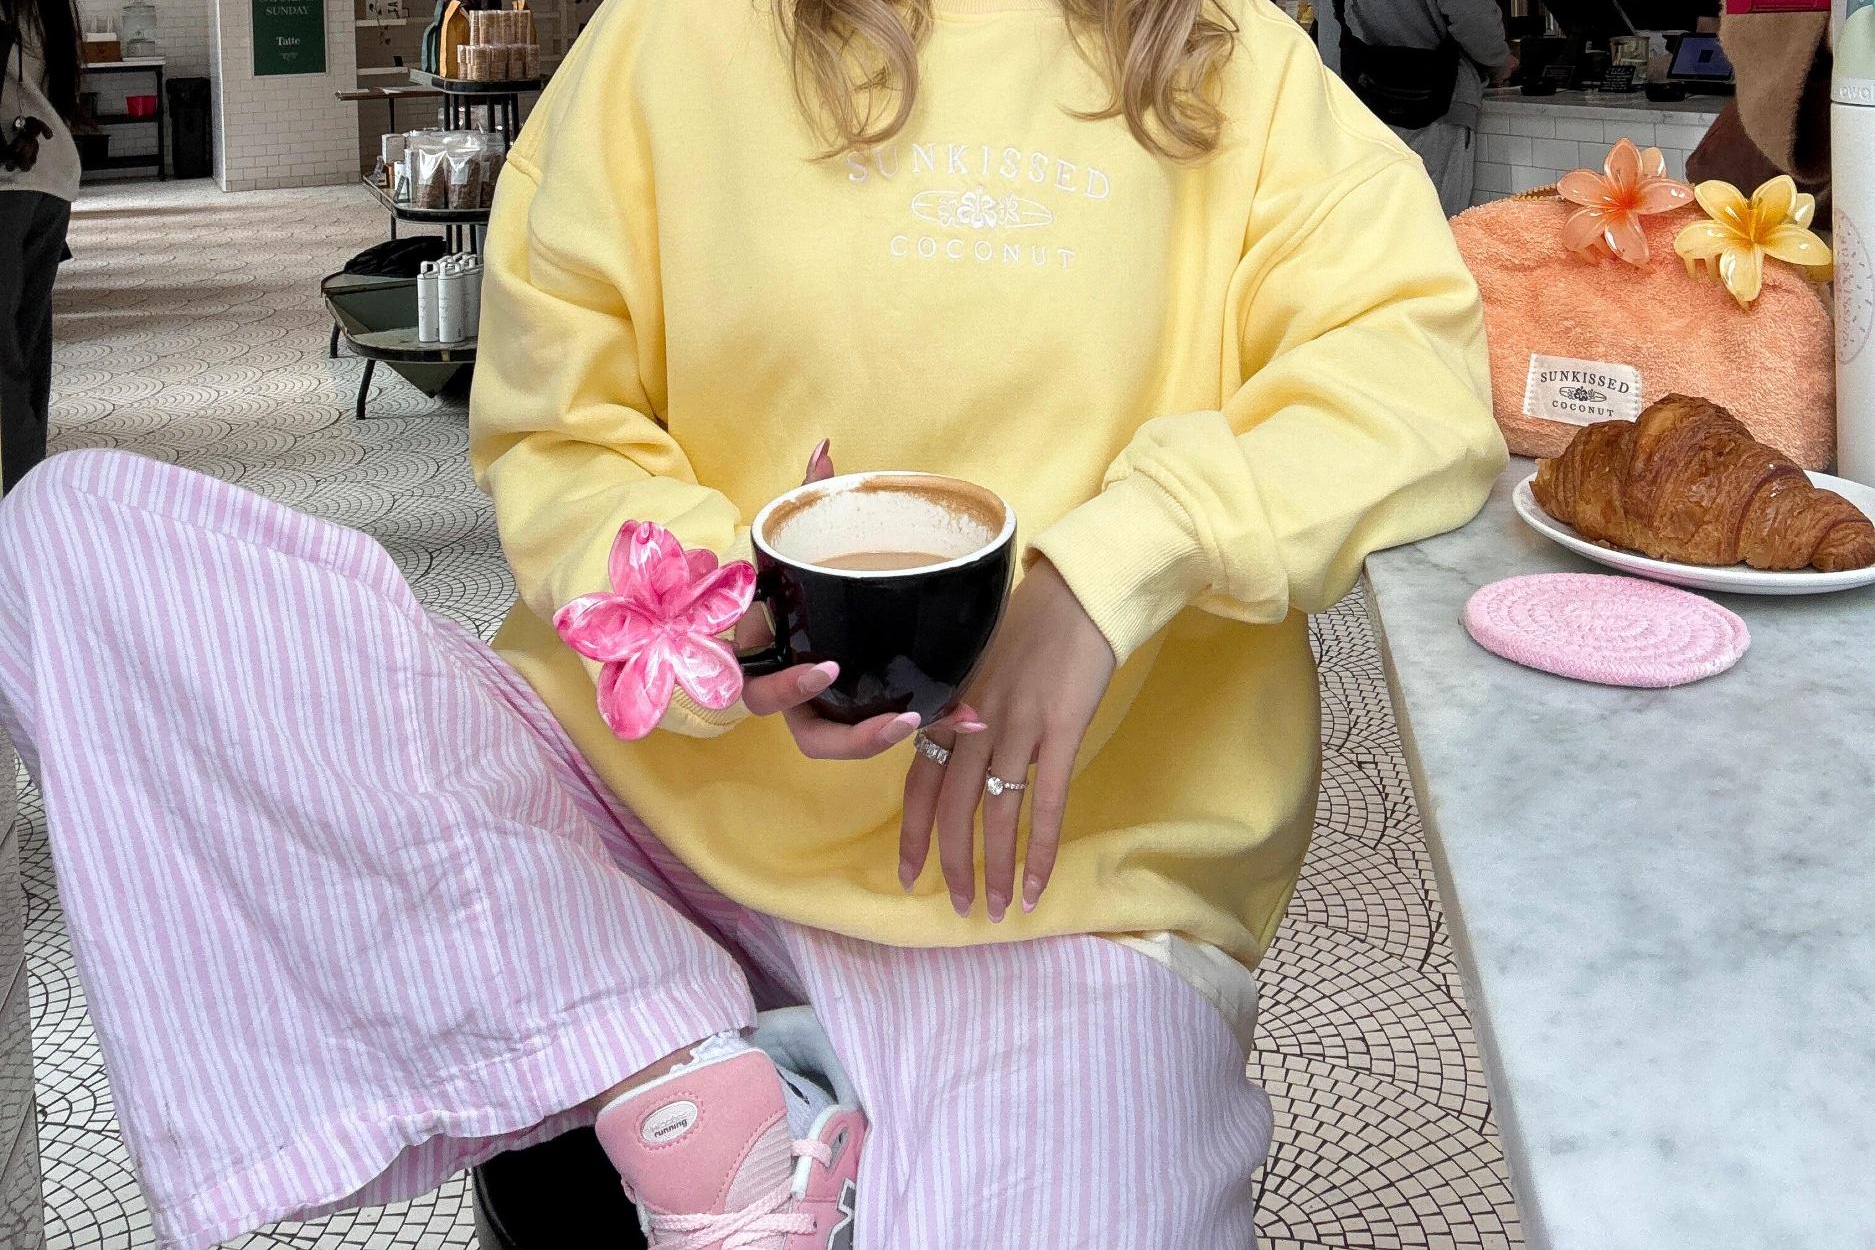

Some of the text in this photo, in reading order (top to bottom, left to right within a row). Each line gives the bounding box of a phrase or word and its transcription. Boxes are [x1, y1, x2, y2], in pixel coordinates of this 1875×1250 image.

[265, 5, 310, 16] SUNDAY
[845, 141, 1111, 200] SUNKISSED
[890, 234, 1076, 270] COCONUT
[1540, 370, 1630, 394] SUNKISSED
[1551, 399, 1614, 417] COCONUT
[654, 1118, 688, 1138] running
